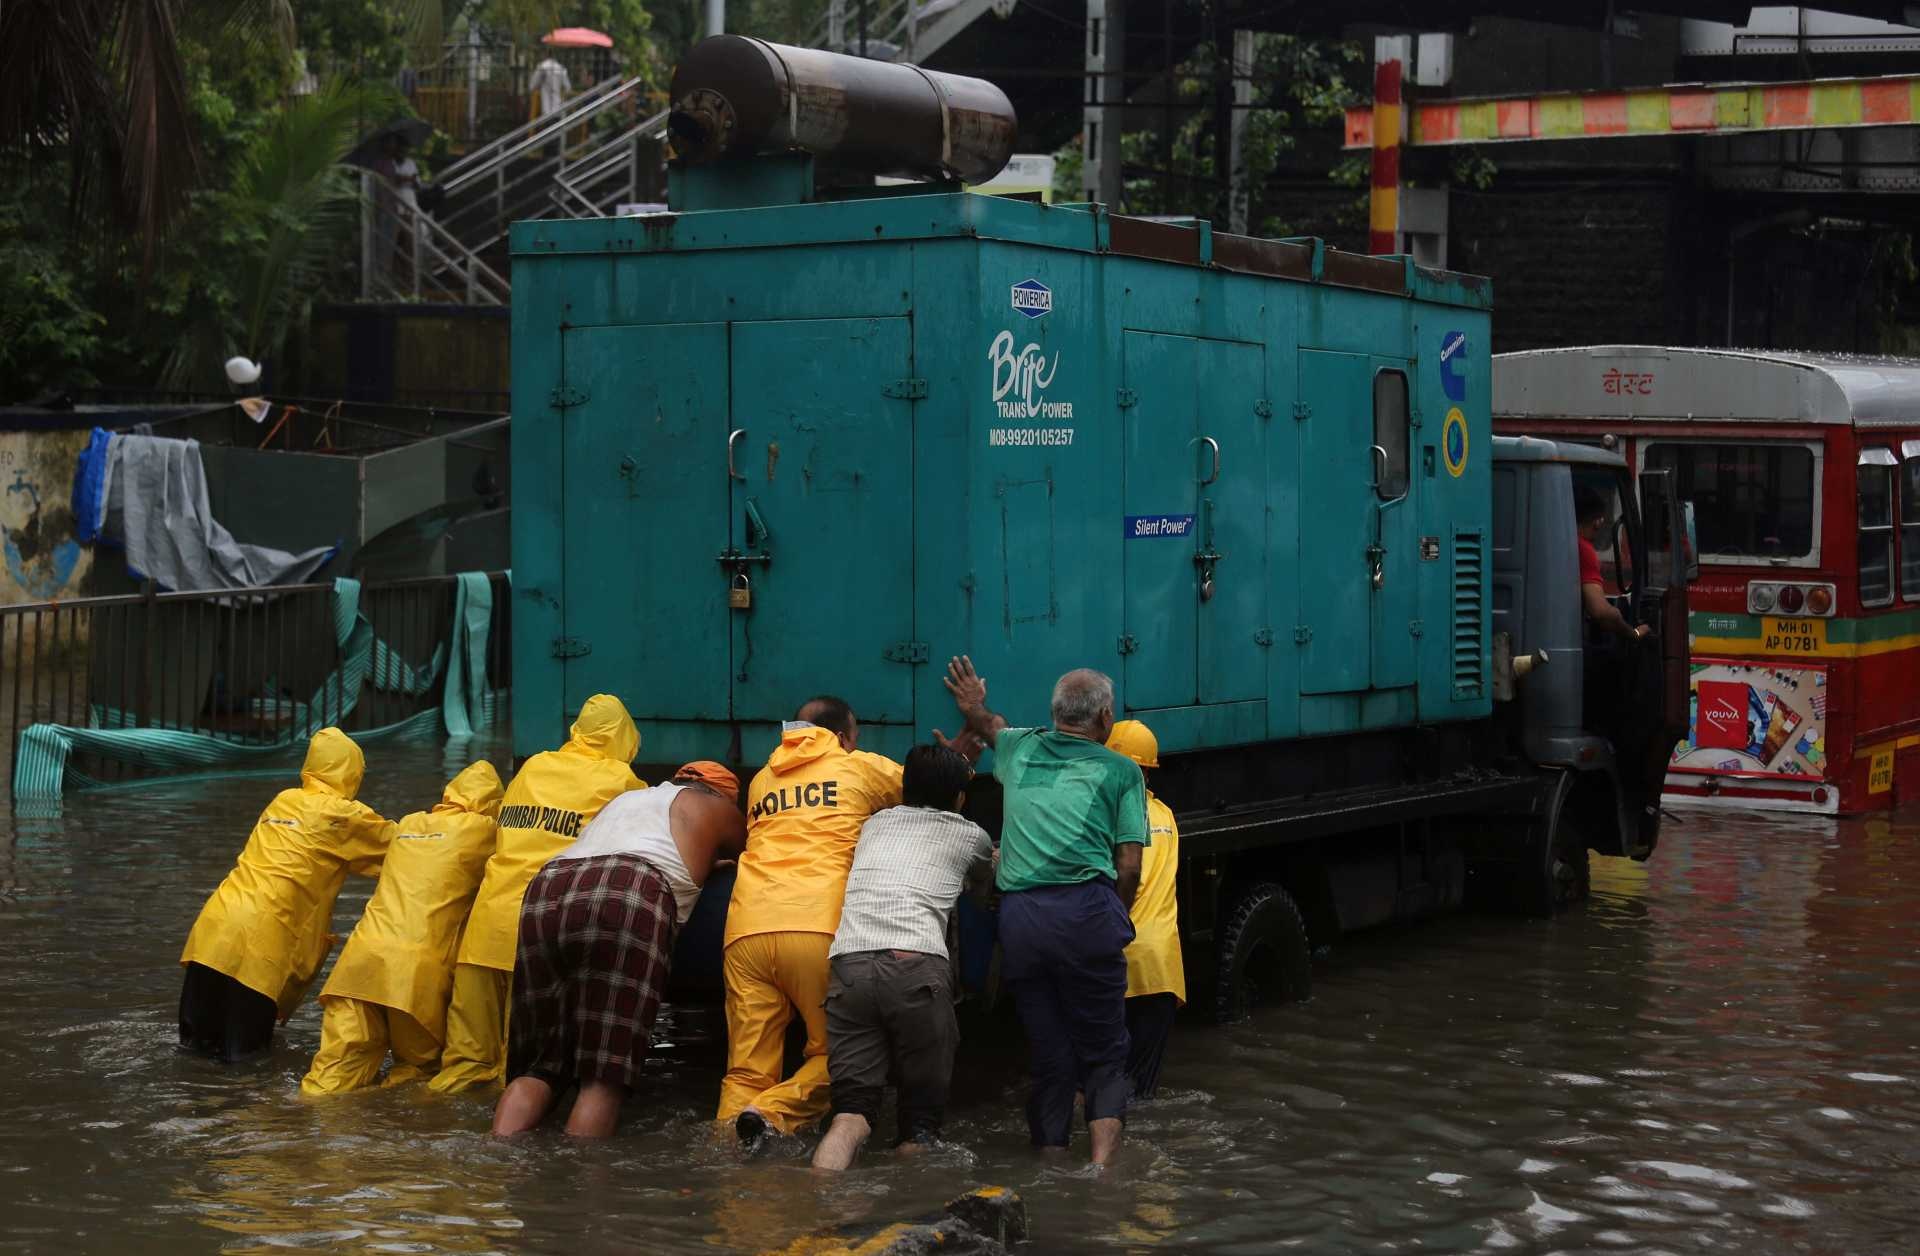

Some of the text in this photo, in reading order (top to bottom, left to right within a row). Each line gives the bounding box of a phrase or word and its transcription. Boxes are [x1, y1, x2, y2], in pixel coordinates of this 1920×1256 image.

[1013, 289, 1050, 308] POWERICA
[1440, 333, 1466, 363] Cummins
[988, 330, 1059, 417] Brite
[997, 402, 1073, 418] TRANS POWER
[1135, 519, 1160, 536] Silent
[751, 781, 838, 821] POLICE
[497, 805, 584, 838] MUMBAI POLICE
